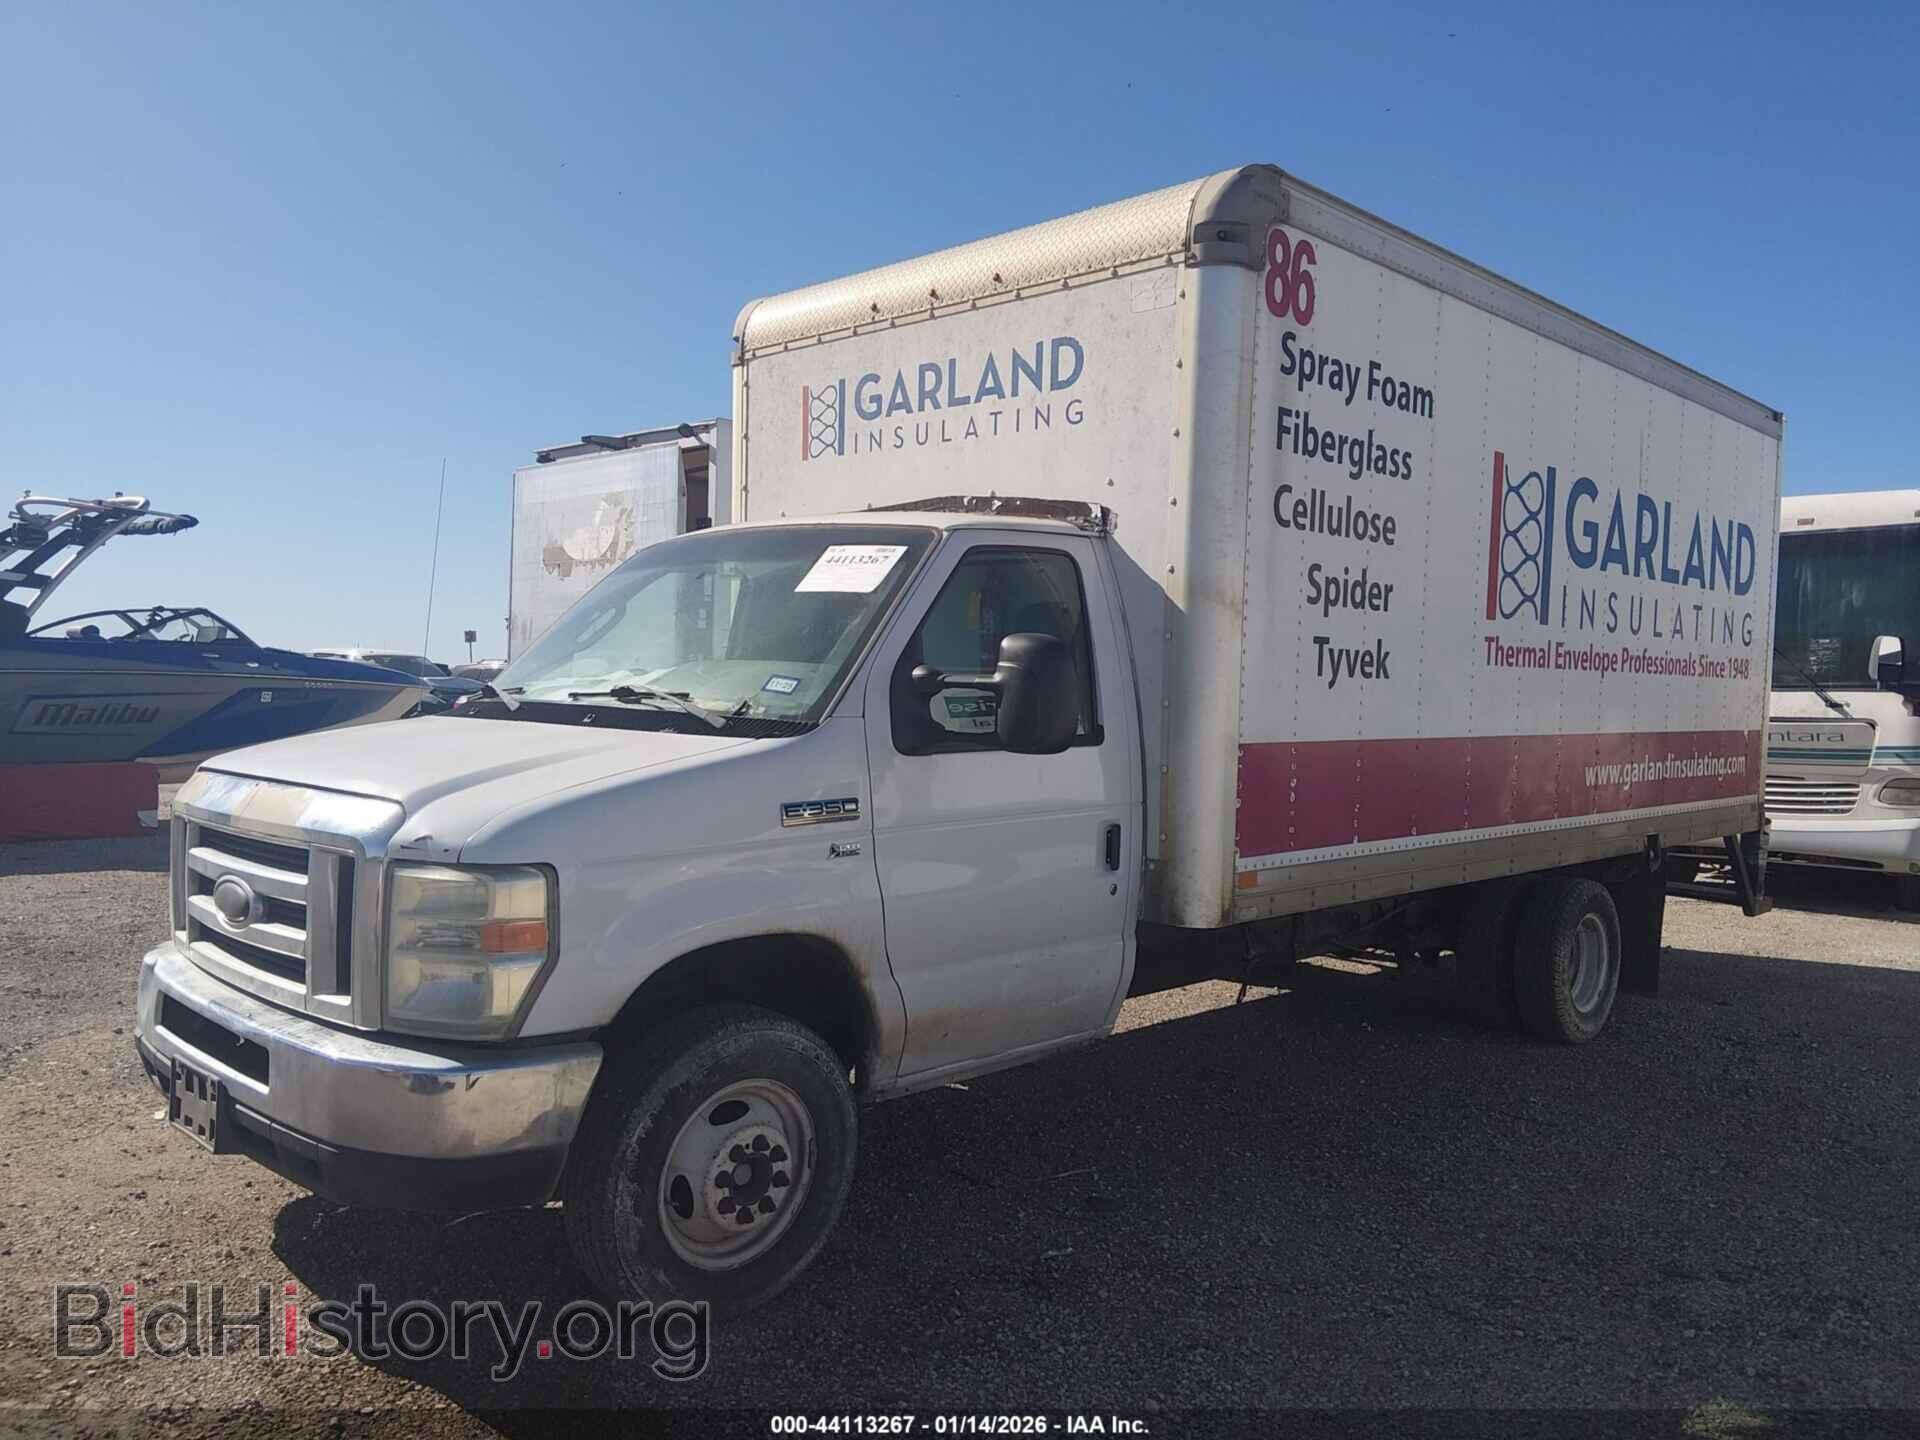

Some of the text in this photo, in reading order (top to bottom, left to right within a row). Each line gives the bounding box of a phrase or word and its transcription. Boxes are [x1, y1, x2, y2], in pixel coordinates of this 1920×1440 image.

[1265, 228, 1317, 326] 86
[854, 336, 1085, 421] GARLAND
[1280, 331, 1434, 419] Spray Foam
[854, 399, 1085, 455] INSULATING
[1276, 405, 1413, 481] Fiberglass
[1273, 483, 1397, 546] Cellulose
[1565, 476, 1756, 596] GARLAND
[1306, 562, 1394, 618] Spider
[1561, 584, 1753, 648] INSULATING
[1312, 635, 1391, 690] Tyvek
[1484, 635, 1750, 680] Thermal Envelope Professionals Since 1948
[33, 703, 160, 727] Malibu
[1584, 751, 1747, 791] www.garlandinsulating.com
